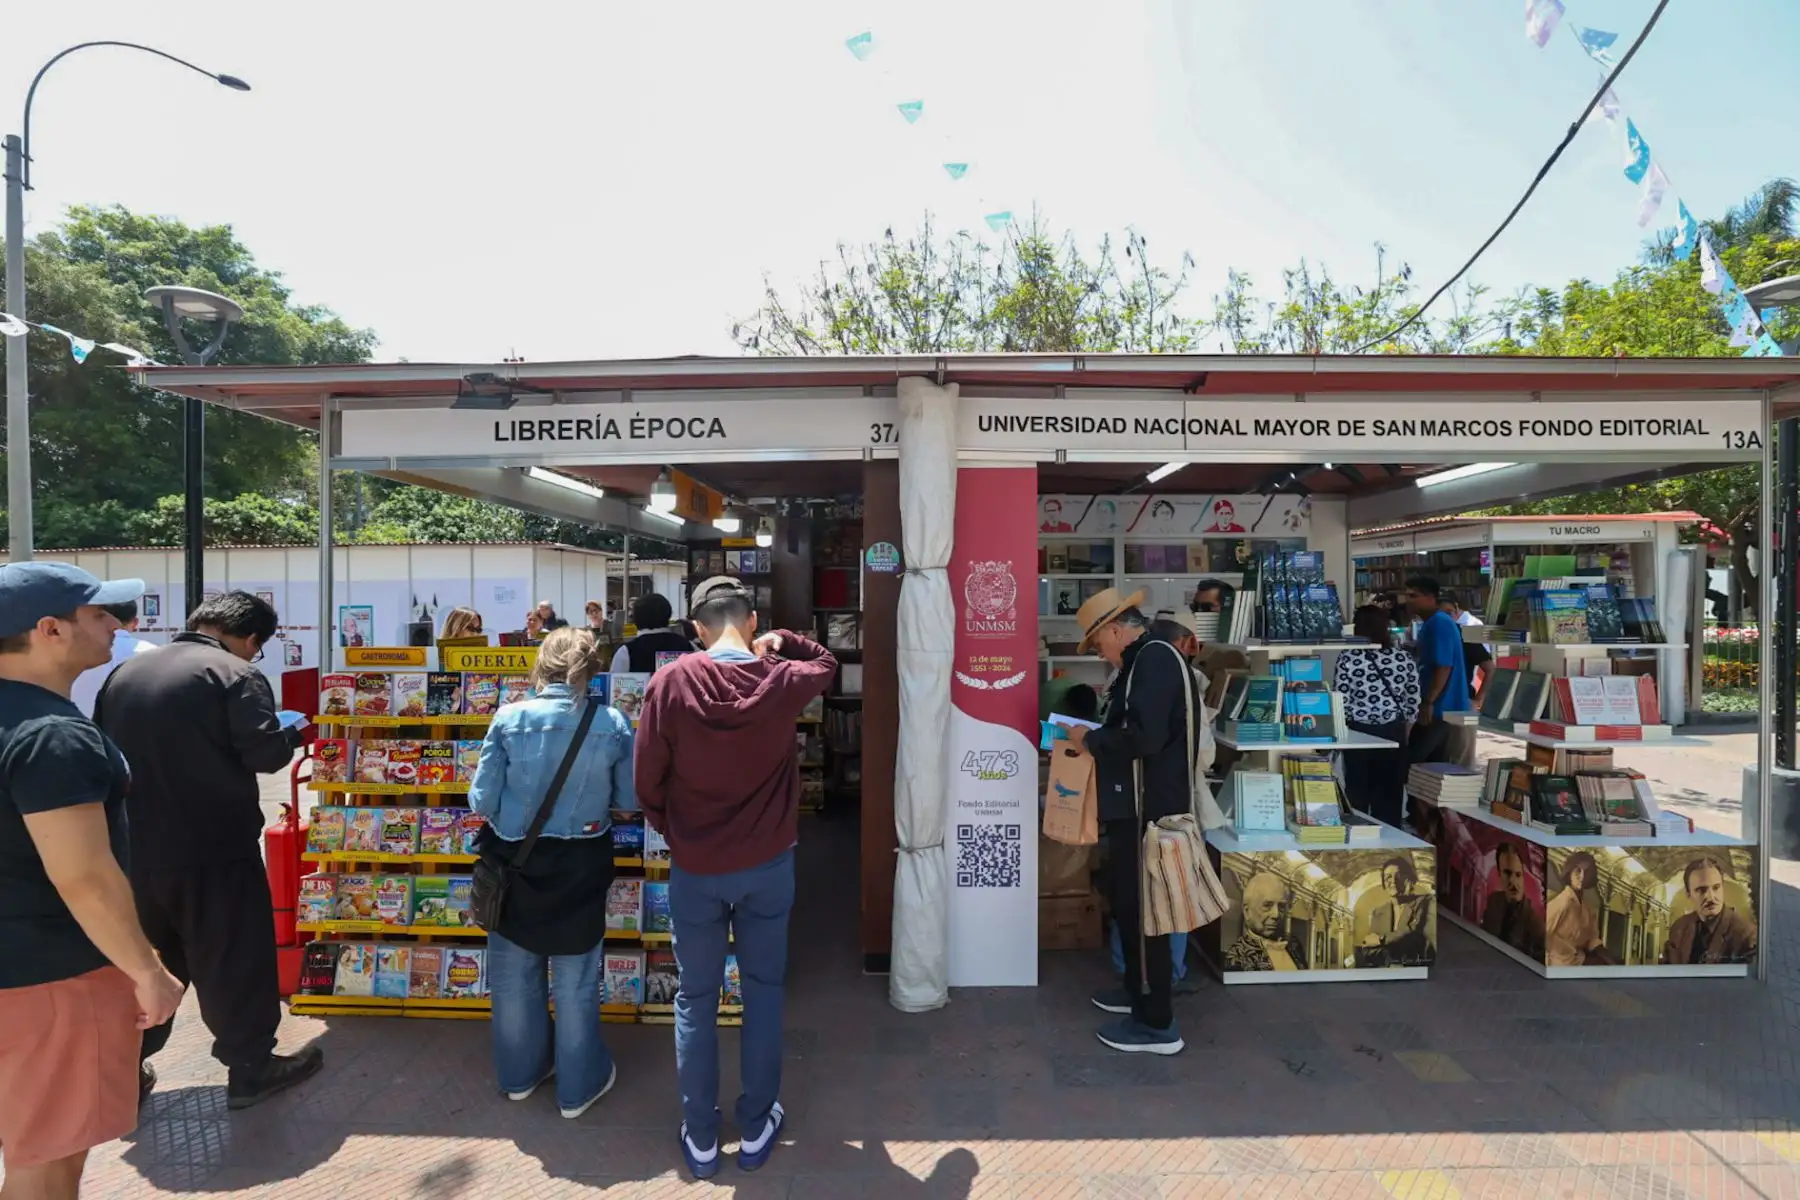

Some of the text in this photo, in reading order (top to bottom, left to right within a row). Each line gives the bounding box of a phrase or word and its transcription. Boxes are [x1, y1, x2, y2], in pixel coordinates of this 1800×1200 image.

[494, 411, 727, 441] LIBRERÍA ÉPOCA
[870, 423, 899, 443] 37
[978, 415, 1710, 437] UNIVERSIDAD NACIONAL MAYOR DE SAN MARCOS FONDO EDITORIAL
[1721, 430, 1763, 450] 13A
[1549, 526, 1601, 535] TU MACRO
[966, 621, 1016, 633] UNMSM
[461, 654, 528, 668] OFERTA
[978, 655, 988, 663] de
[990, 656, 1012, 665] mayo
[960, 750, 1019, 778] 473
[957, 799, 1020, 808] Fondo Editorial
[302, 879, 333, 891] DIETAS
